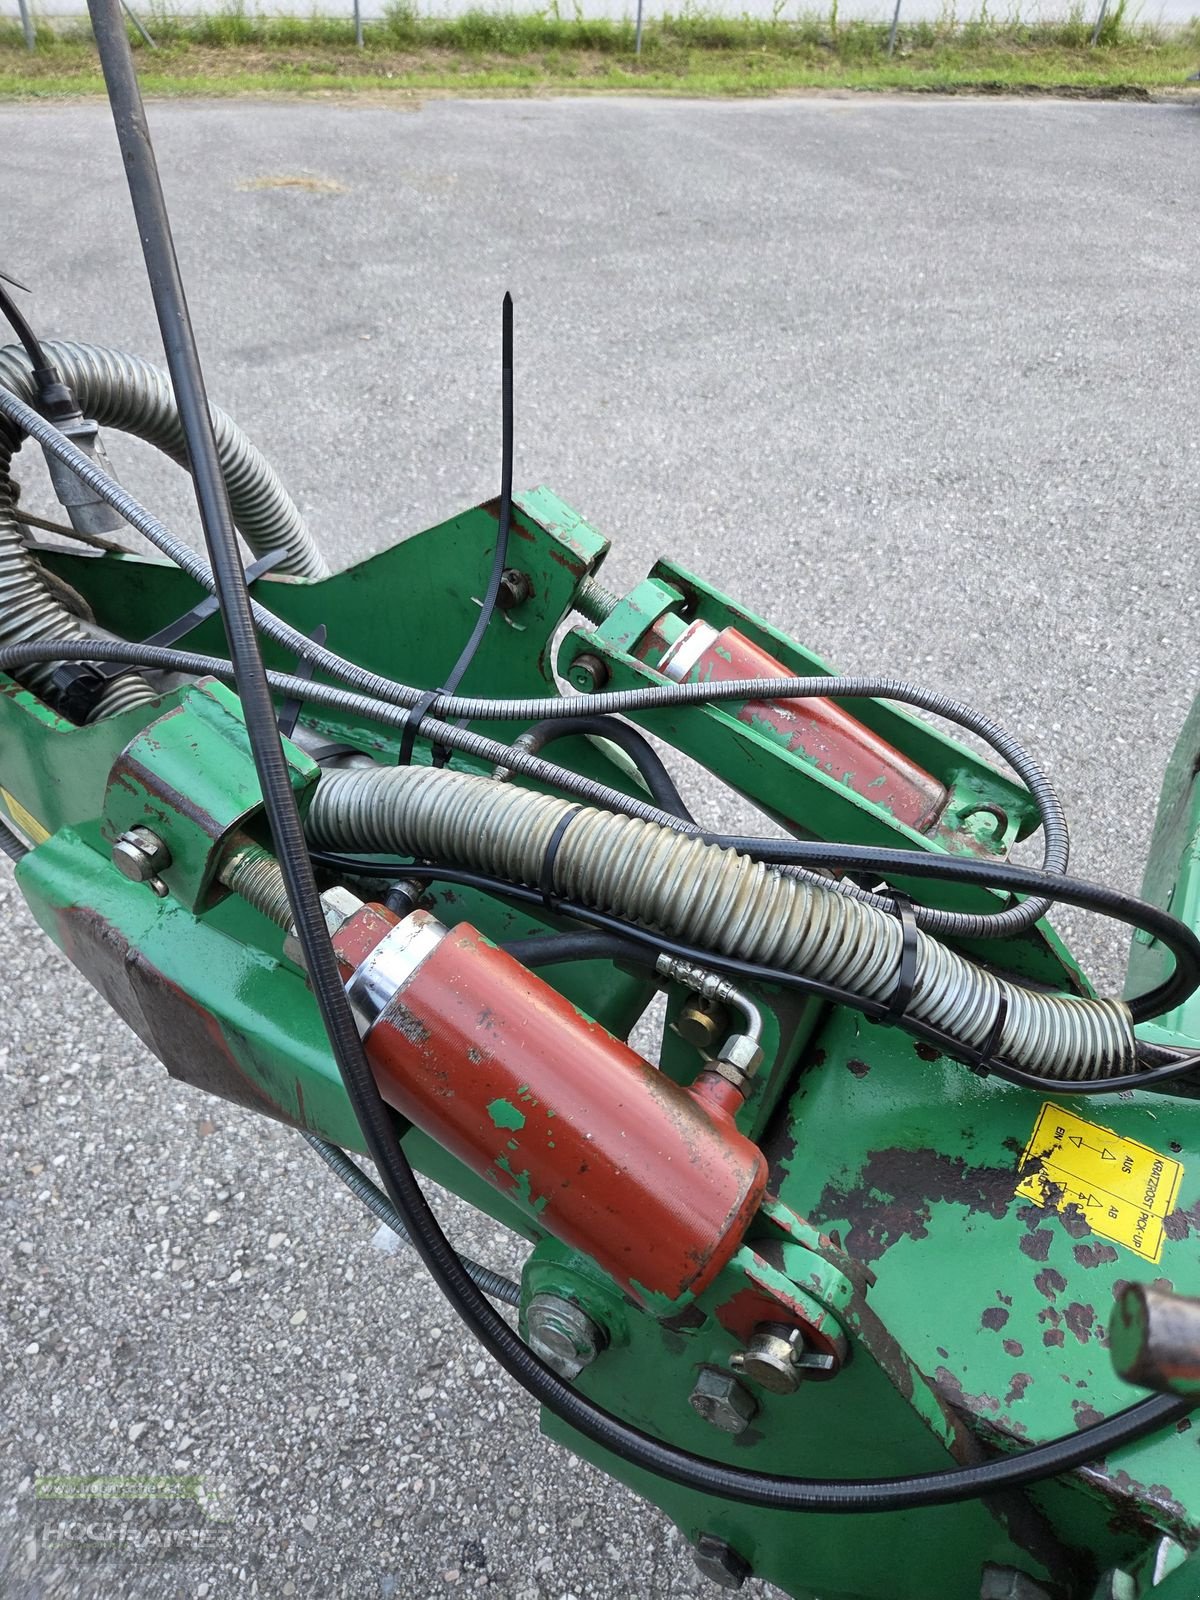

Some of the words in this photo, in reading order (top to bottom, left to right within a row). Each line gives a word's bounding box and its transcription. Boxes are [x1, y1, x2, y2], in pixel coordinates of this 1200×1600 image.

[1054, 1126, 1066, 1141] EIN
[1121, 1155, 1134, 1174] AUS
[1142, 1158, 1165, 1210] KRATZROST
[1108, 1205, 1120, 1220] AB
